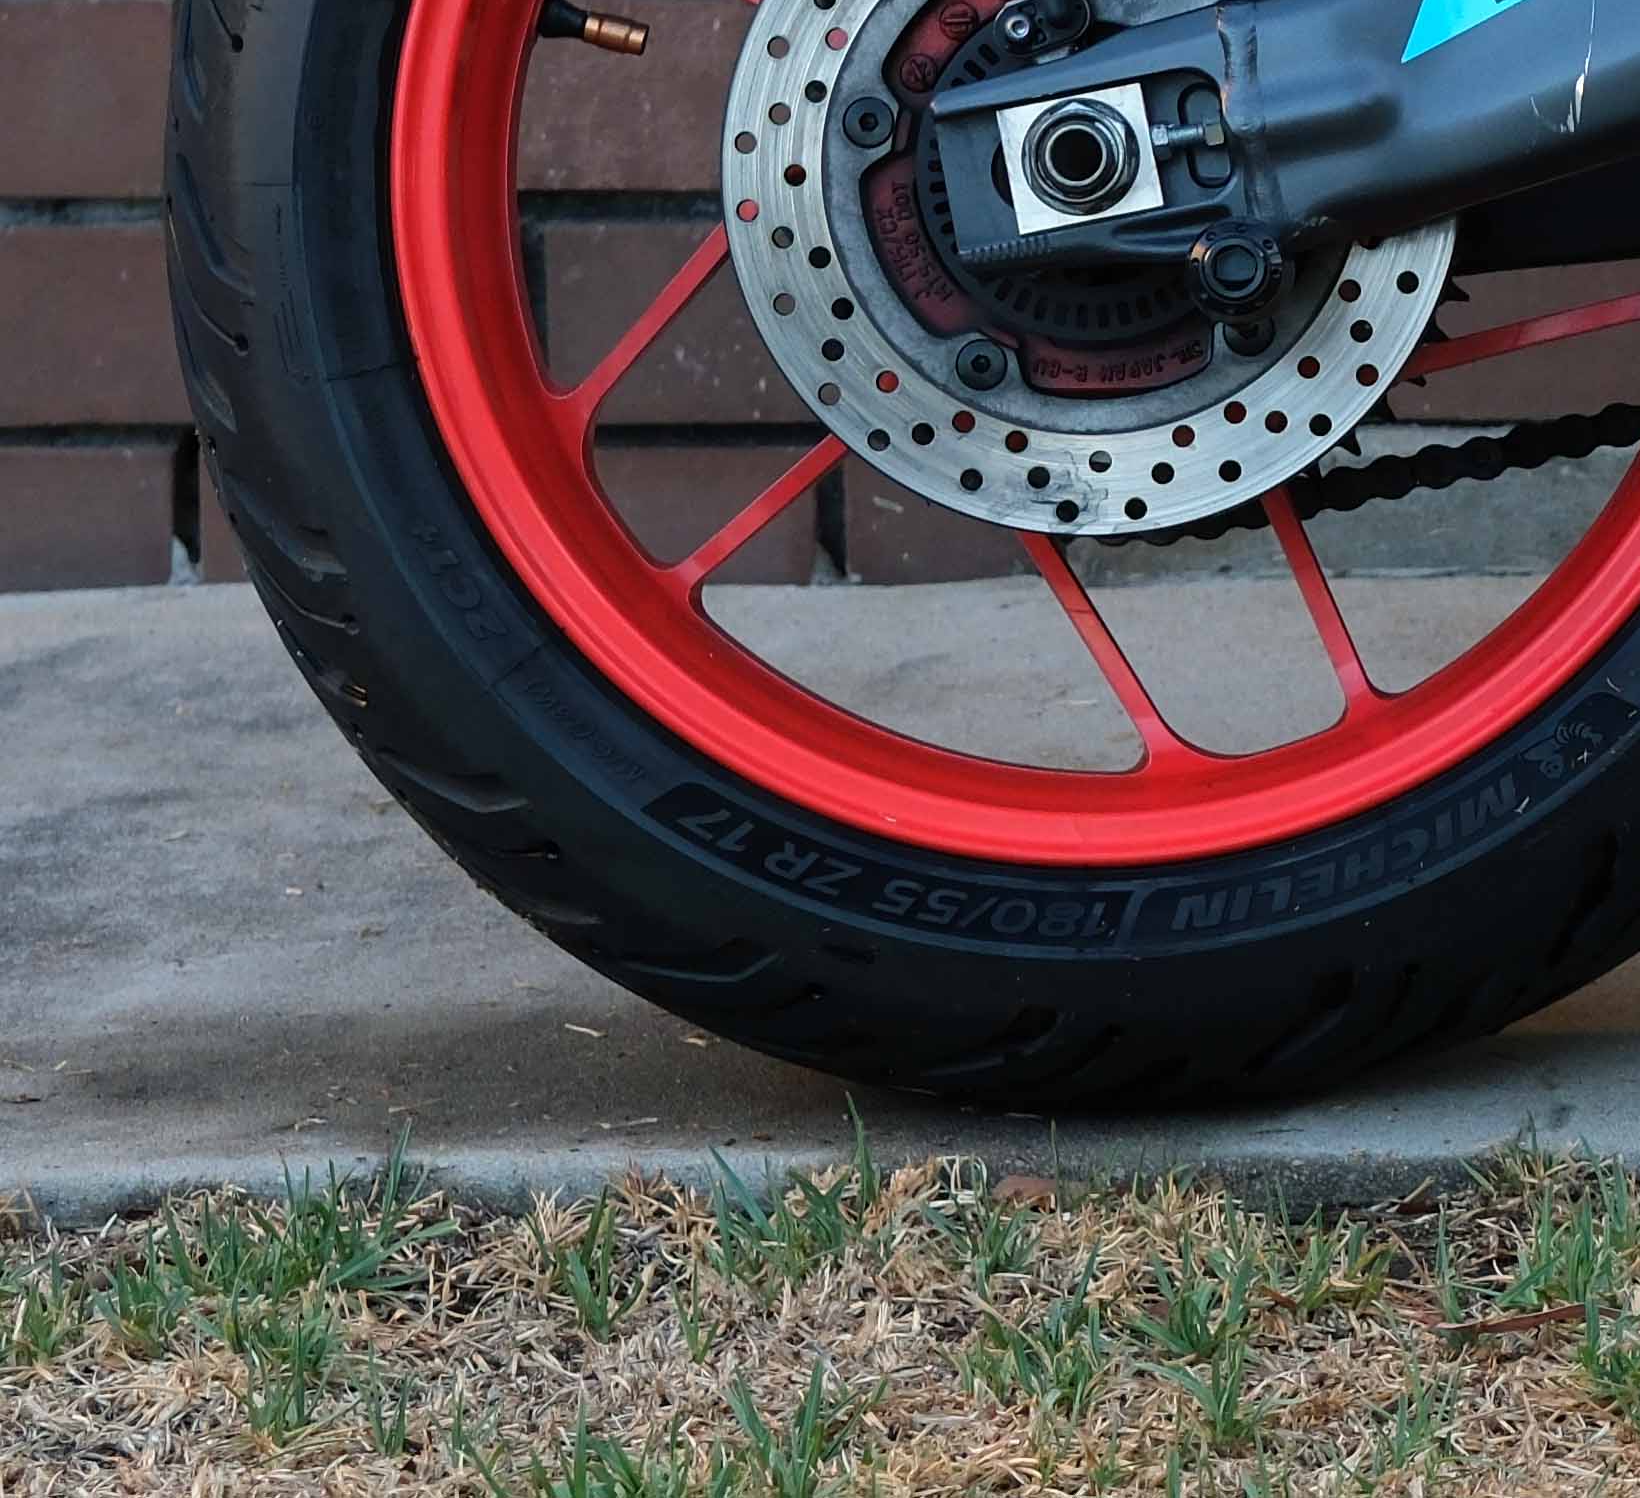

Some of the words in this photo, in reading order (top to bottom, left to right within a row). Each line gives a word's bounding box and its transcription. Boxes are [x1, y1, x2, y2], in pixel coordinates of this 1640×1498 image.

[677, 806, 755, 854] 17
[1170, 772, 1528, 932] MICHELIN
[764, 839, 864, 901] ZR
[873, 876, 1118, 940] 180/55
